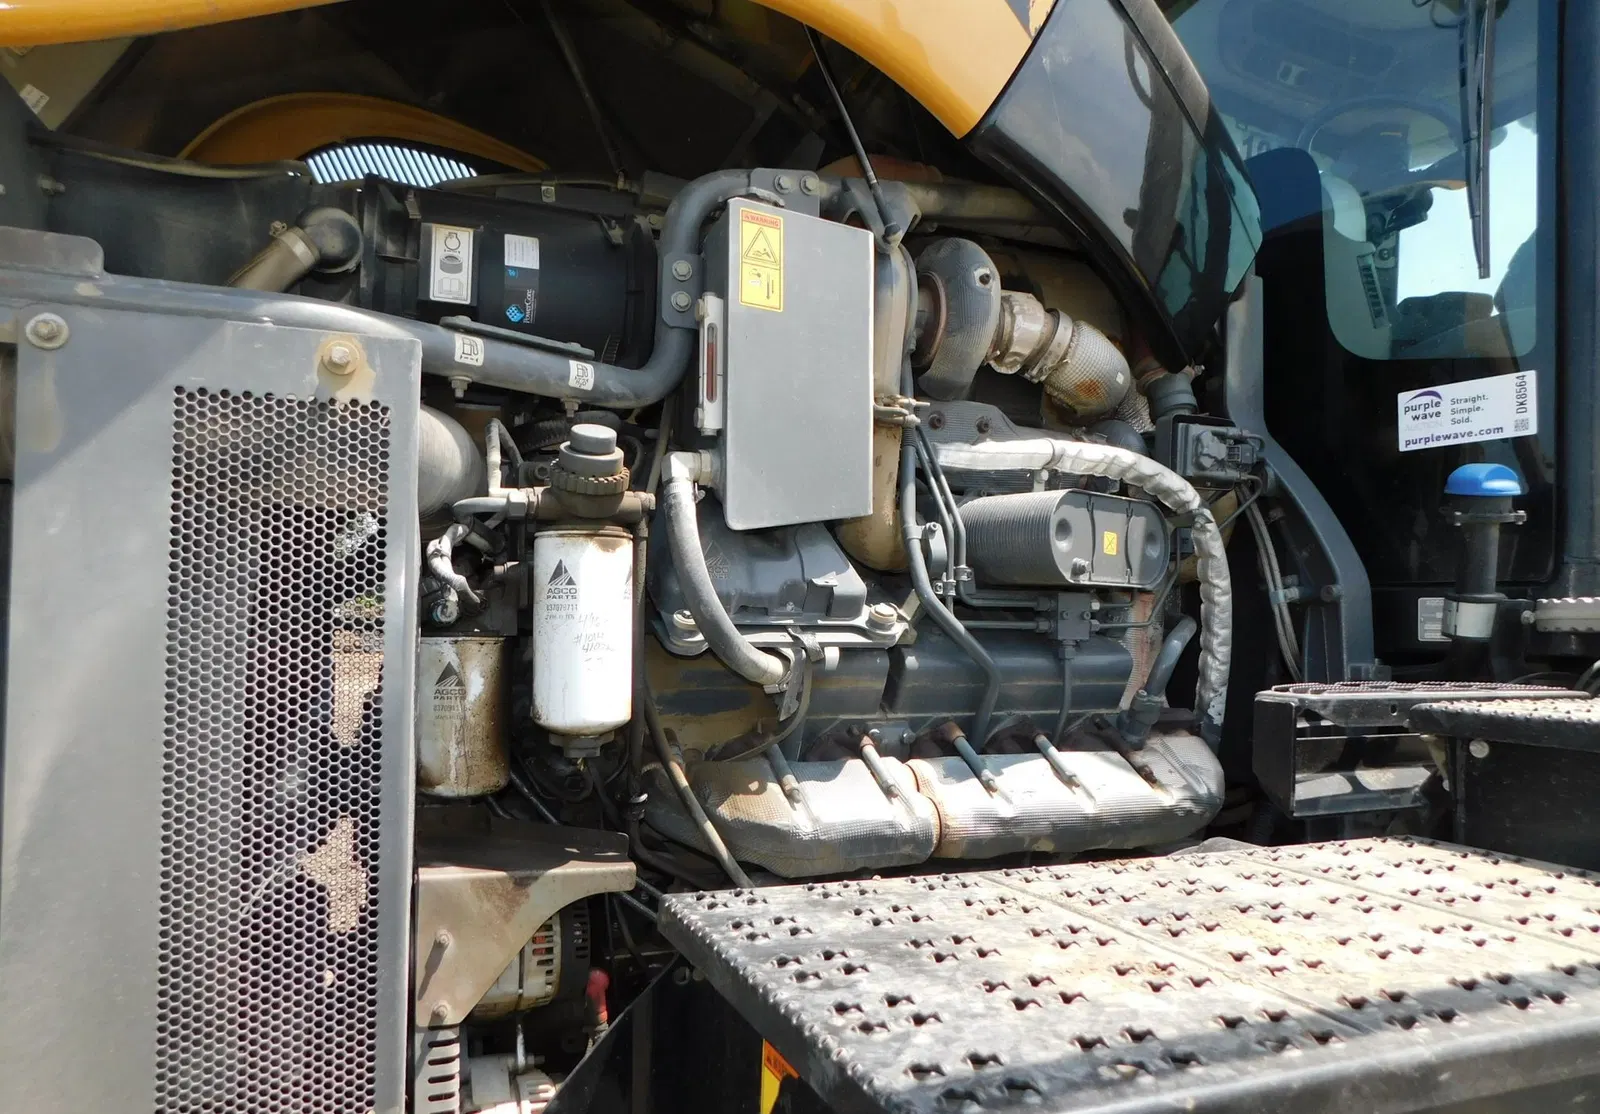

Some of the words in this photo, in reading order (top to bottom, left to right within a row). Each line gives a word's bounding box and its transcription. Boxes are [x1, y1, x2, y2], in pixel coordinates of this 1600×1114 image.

[750, 214, 779, 227] WARNING
[1515, 374, 1528, 414] DK8564
[1450, 394, 1489, 406] Straight.
[1404, 399, 1441, 415] purple
[1450, 405, 1484, 415] Simple.
[1411, 410, 1442, 421] wave
[1450, 416, 1472, 425] Sold.
[1404, 426, 1504, 448] purplewave.com
[547, 587, 578, 595] AGCO
[434, 688, 467, 696] AGCO
